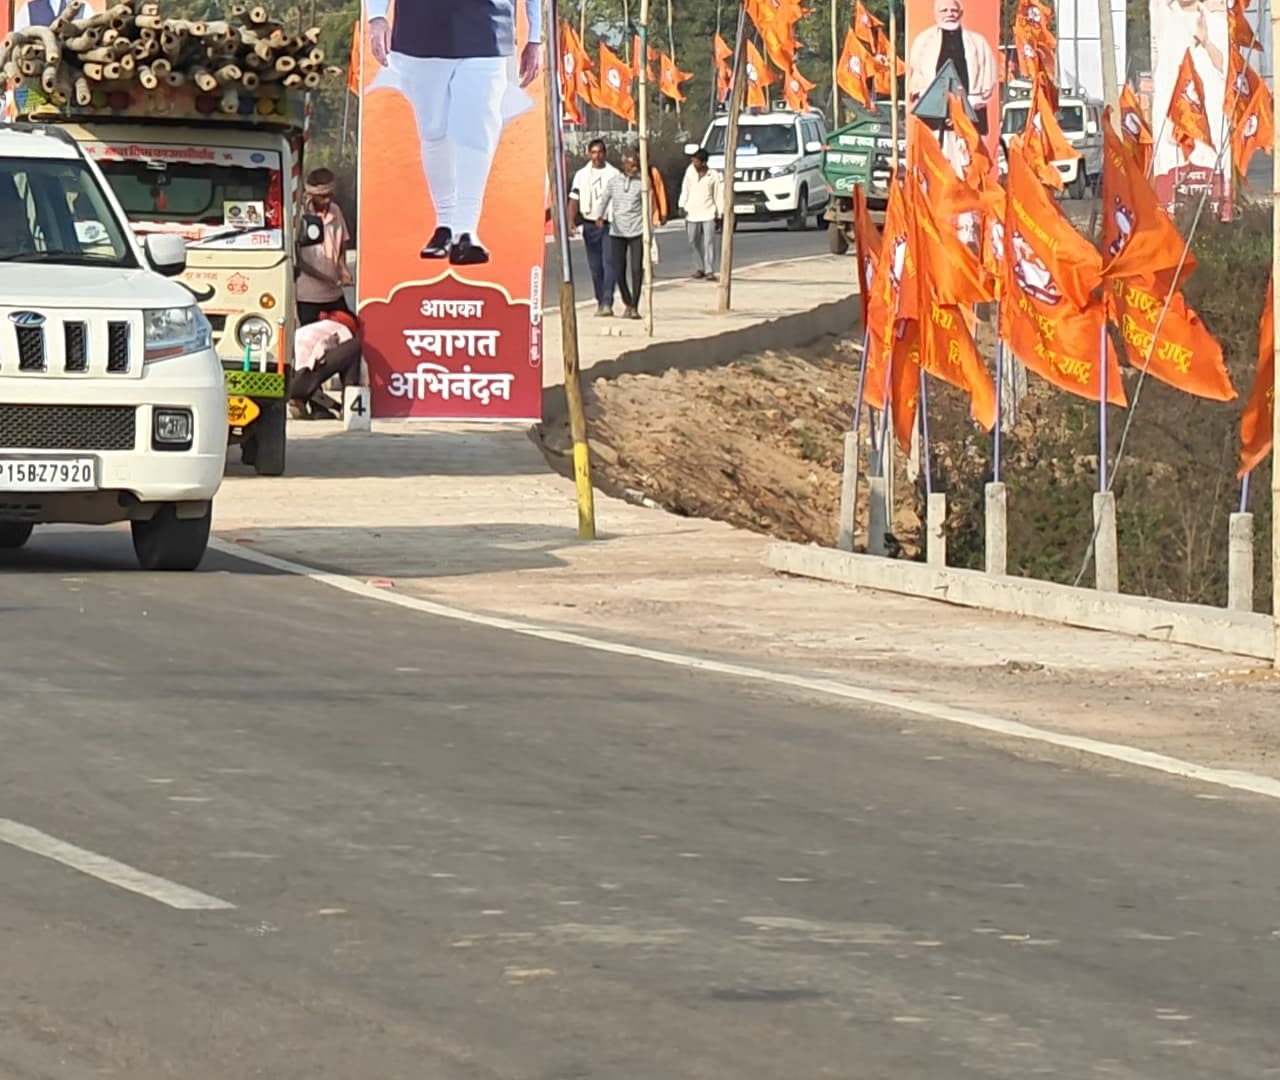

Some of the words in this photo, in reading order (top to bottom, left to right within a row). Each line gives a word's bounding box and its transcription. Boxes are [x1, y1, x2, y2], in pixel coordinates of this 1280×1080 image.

[420, 299, 485, 318] आपका
[1127, 286, 1161, 323] राष्ट्र
[402, 329, 501, 357] स्वागत
[1157, 340, 1193, 374] राष्ट्र
[388, 362, 515, 405] अभिनंदन
[349, 394, 366, 416] 4
